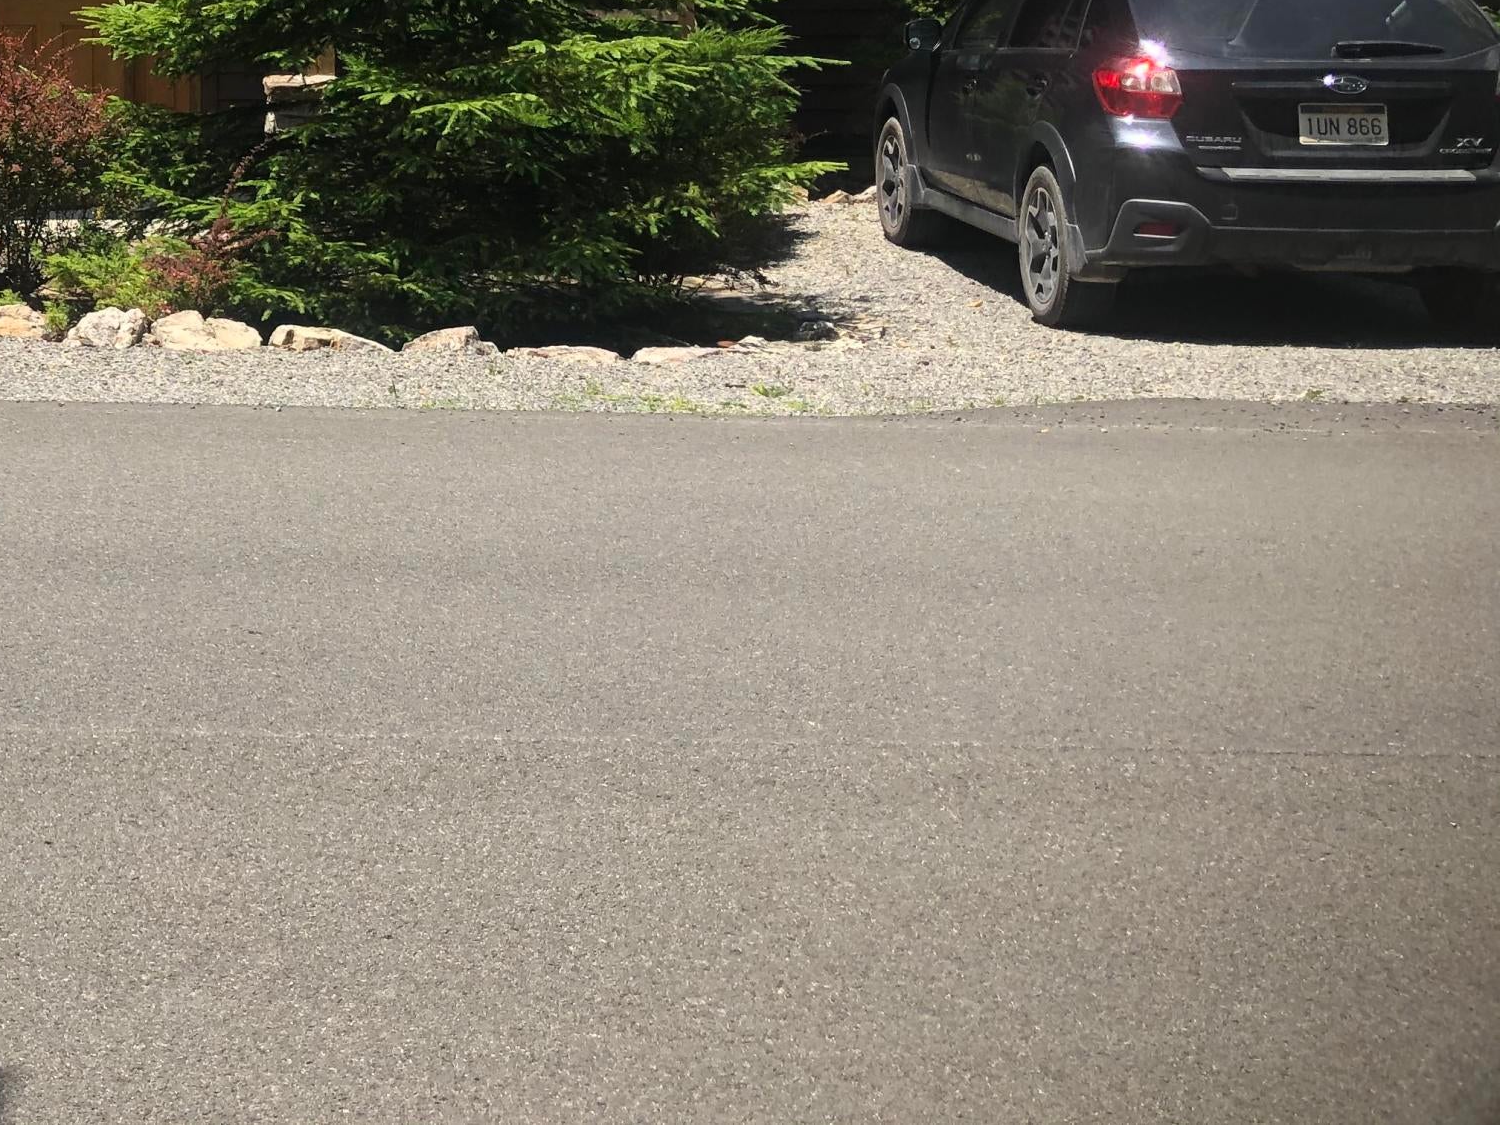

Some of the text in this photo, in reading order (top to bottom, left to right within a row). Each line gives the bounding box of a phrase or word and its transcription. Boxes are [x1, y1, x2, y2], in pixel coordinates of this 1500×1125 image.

[1308, 117, 1382, 136] 1UN 866
[1186, 135, 1242, 144] SUBARU
